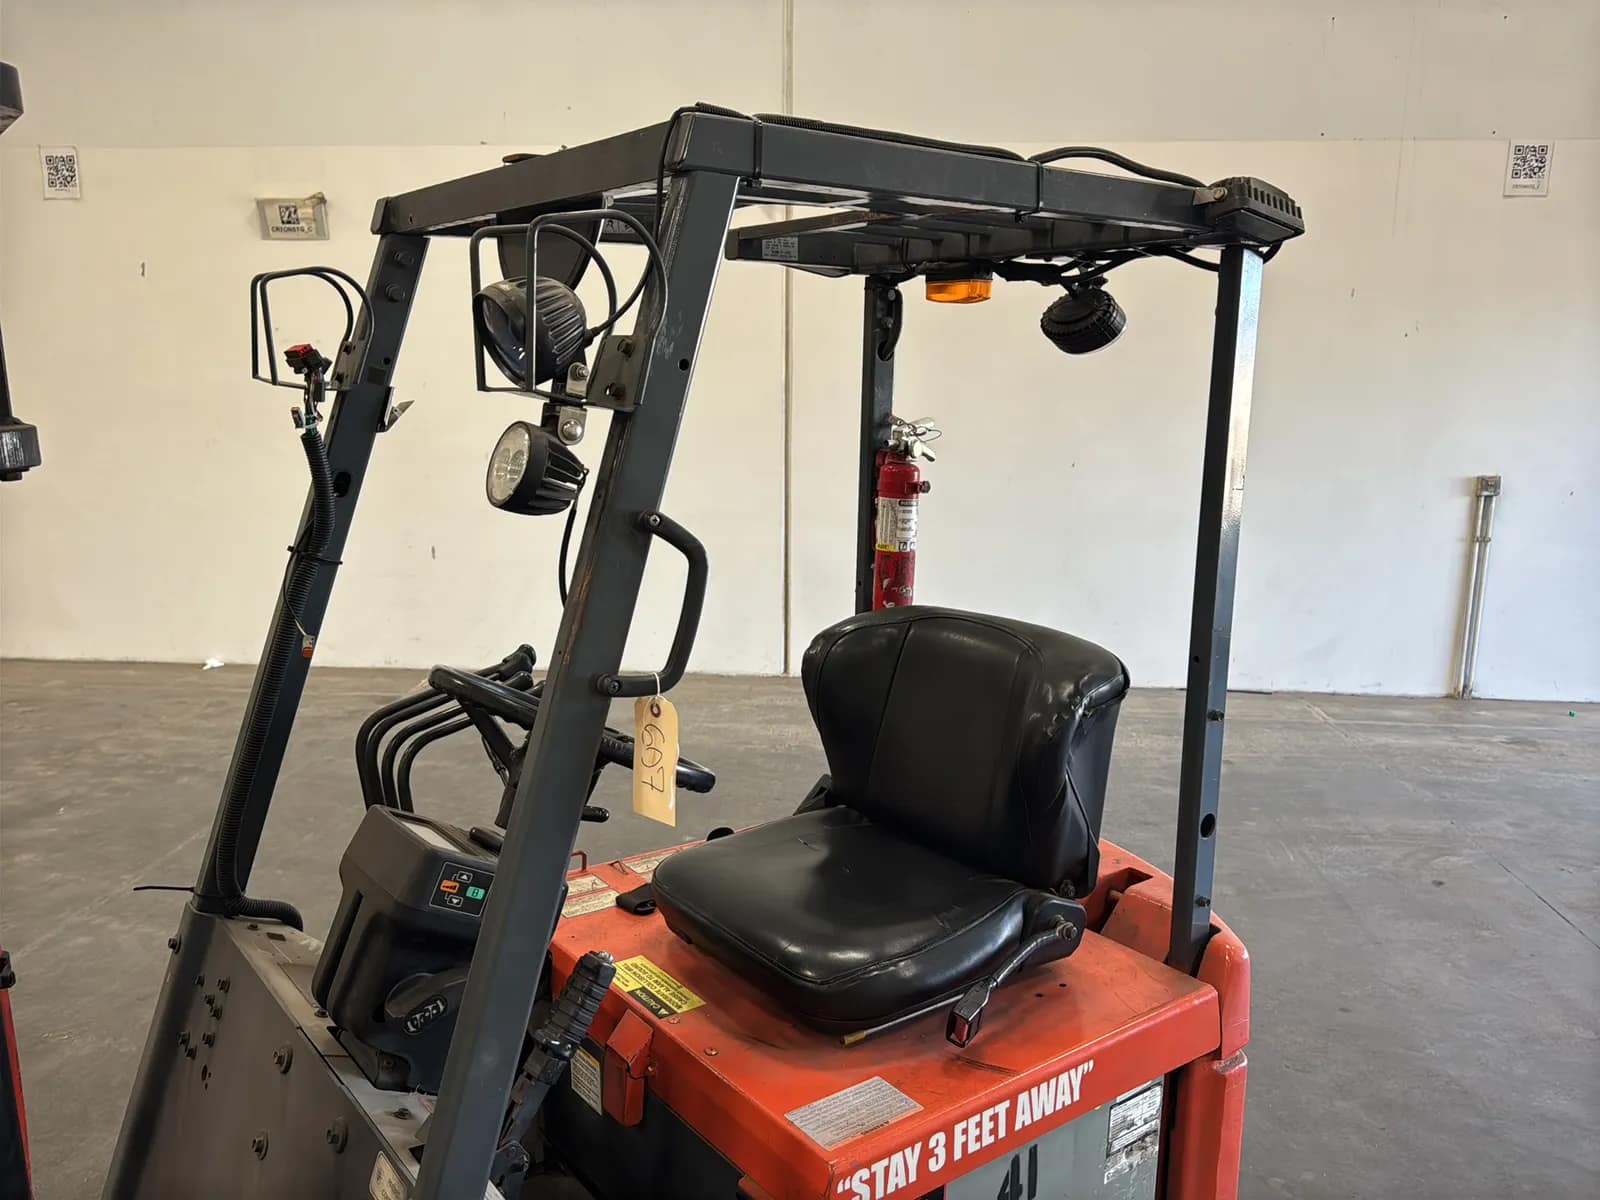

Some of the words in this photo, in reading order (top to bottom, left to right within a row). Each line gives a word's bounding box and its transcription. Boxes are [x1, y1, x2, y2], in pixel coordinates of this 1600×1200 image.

[641, 723, 665, 793] 607
[634, 990, 660, 1008] CAUTION
[928, 1131, 946, 1173] 3
[954, 1099, 1010, 1161] FEET
